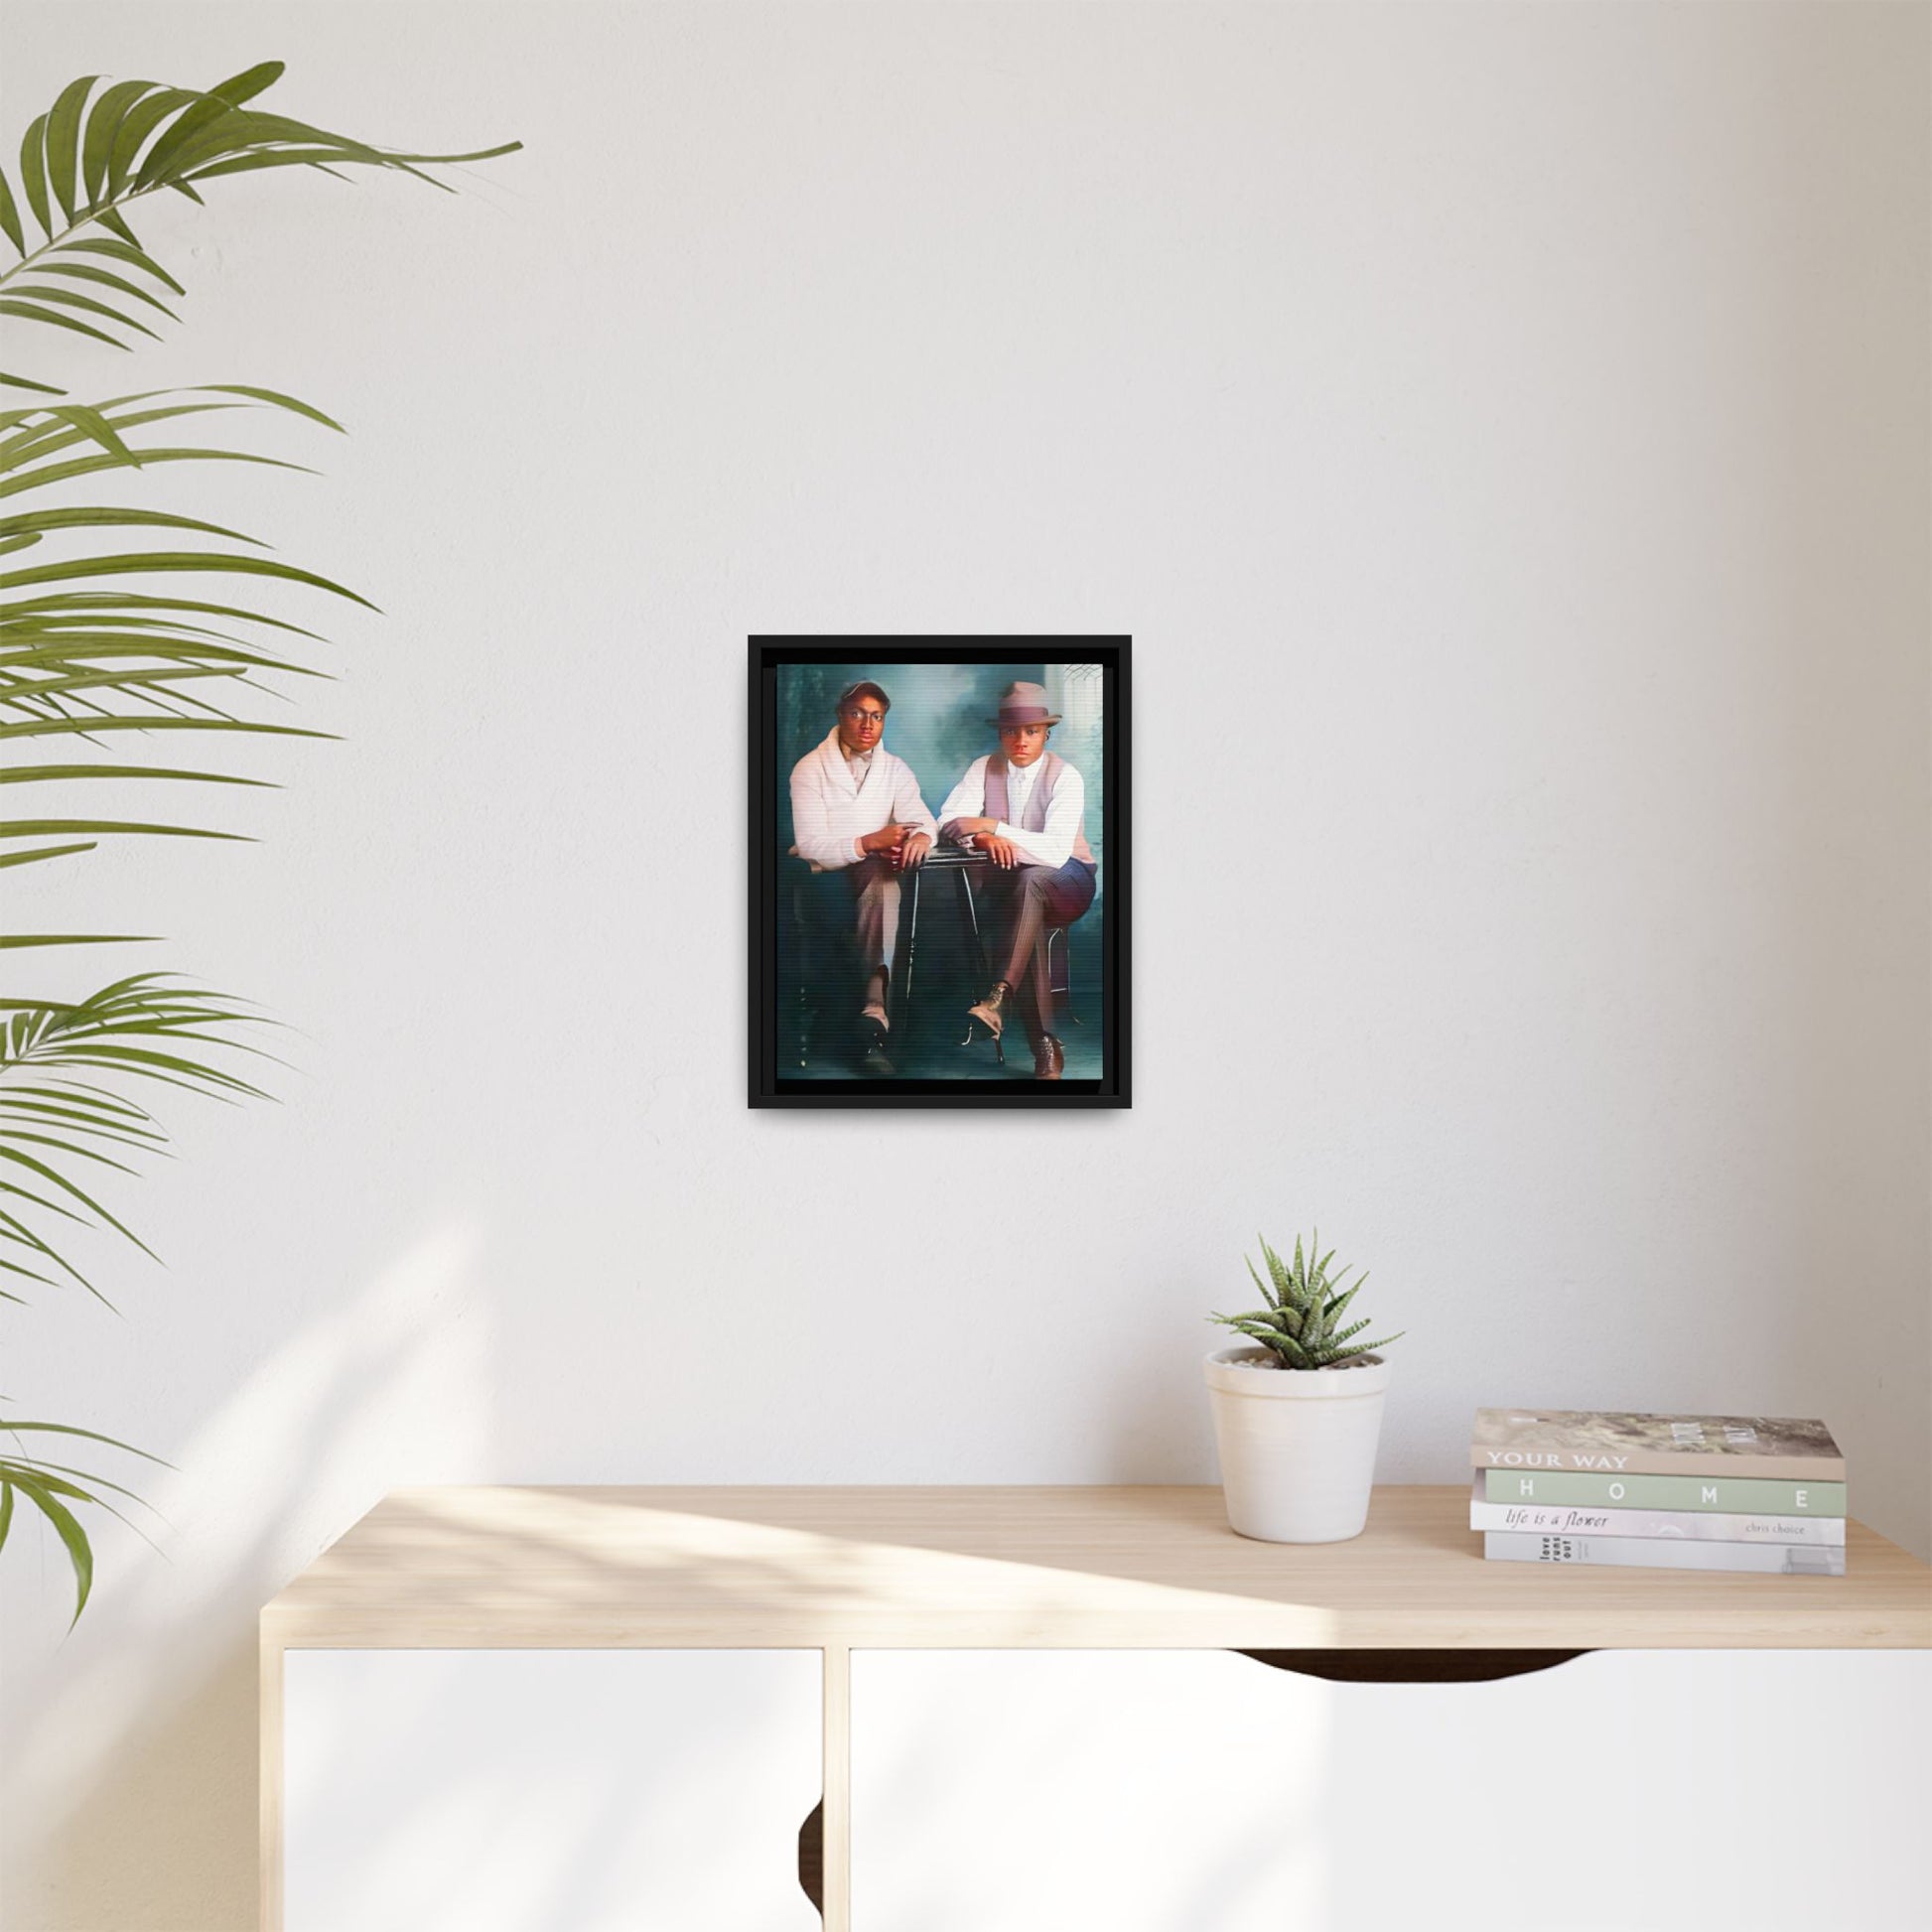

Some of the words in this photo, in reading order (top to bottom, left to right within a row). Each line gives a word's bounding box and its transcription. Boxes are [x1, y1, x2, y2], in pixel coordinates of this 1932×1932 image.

[1487, 1451, 1563, 1466] YOUR
[1573, 1454, 1628, 1468] WAY
[1505, 1508, 1529, 1529] life
[1534, 1513, 1546, 1526] is
[1551, 1517, 1559, 1526] a
[1561, 1511, 1609, 1531] flower
[1745, 1522, 1769, 1534] chris
[1772, 1523, 1805, 1535] choice
[1539, 1537, 1550, 1560] love
[1552, 1537, 1561, 1561] runs
[1562, 1540, 1572, 1559] out
